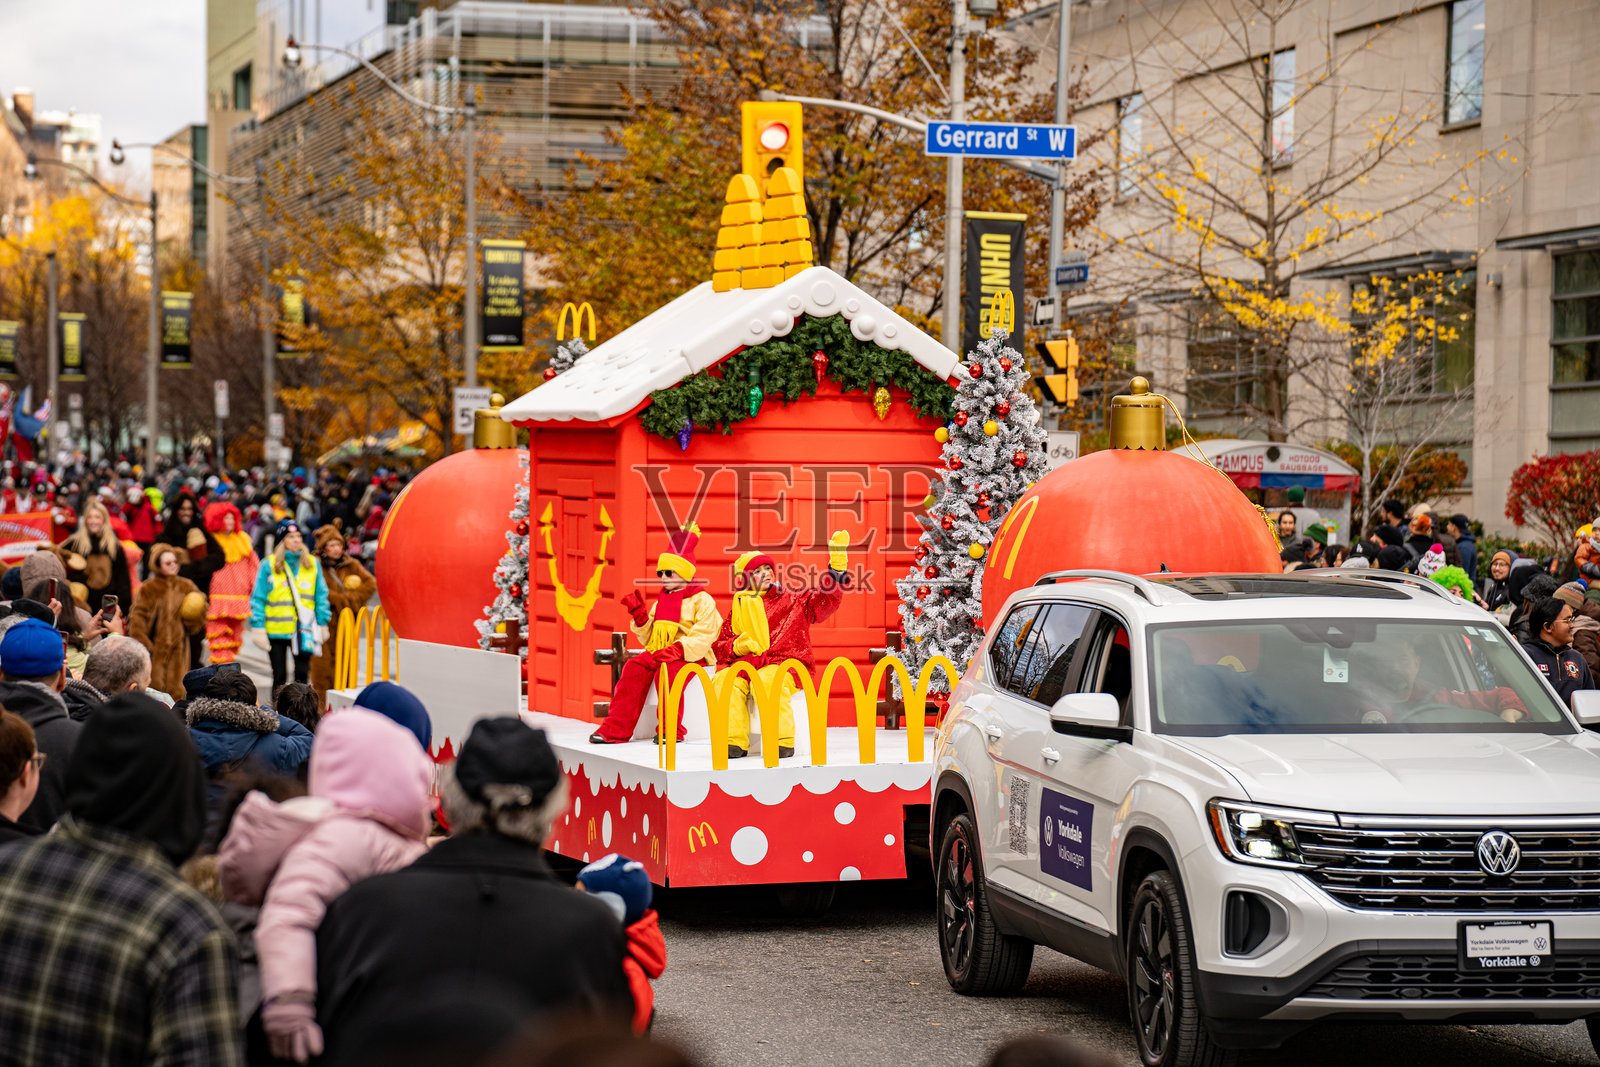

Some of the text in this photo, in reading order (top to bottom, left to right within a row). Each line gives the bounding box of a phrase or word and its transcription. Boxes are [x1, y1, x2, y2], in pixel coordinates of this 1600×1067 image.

[936, 124, 1067, 151] Gerrard St W
[1215, 454, 1264, 471] FAMOUS
[1057, 819, 1083, 844] Yorkdale
[1057, 843, 1085, 869] Volkswagen
[1479, 956, 1527, 967] Yorkdale
